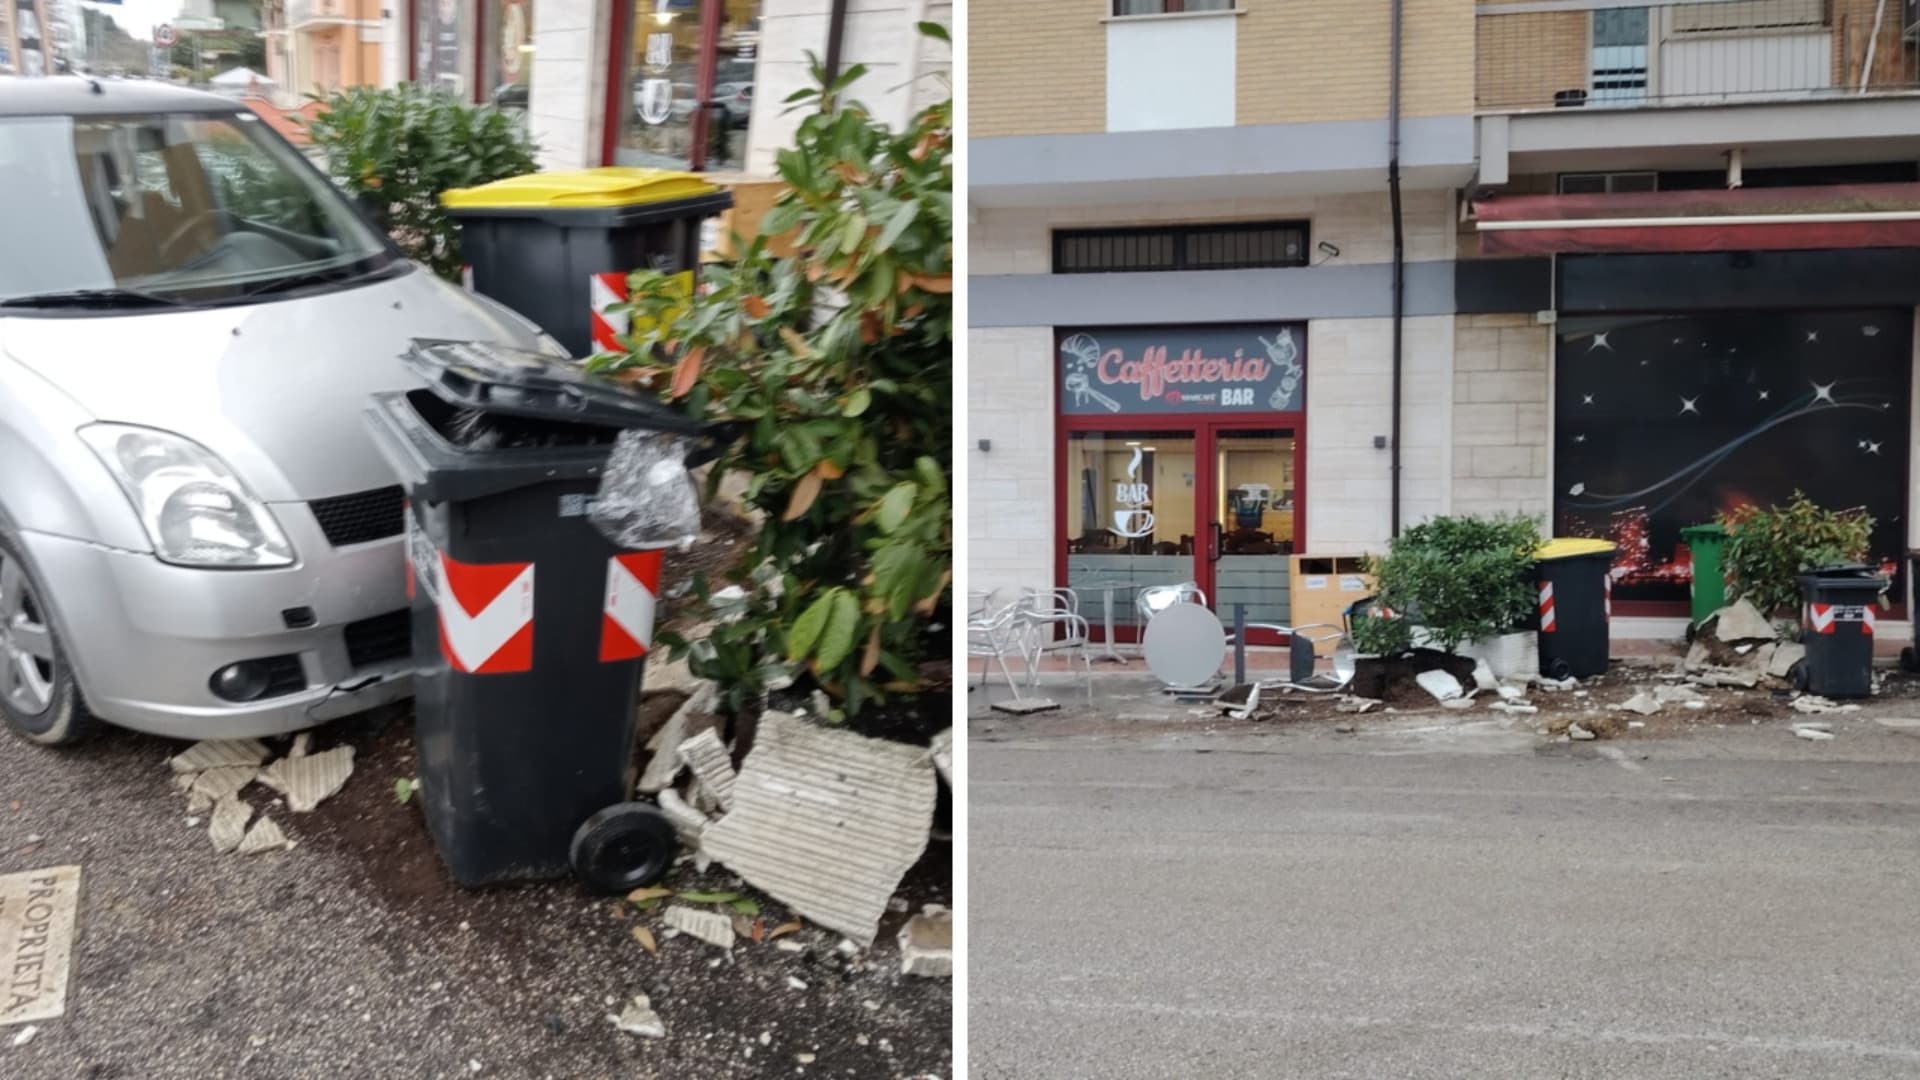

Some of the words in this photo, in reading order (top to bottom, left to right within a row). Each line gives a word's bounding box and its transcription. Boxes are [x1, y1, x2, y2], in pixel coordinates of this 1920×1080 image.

[1097, 345, 1271, 401] Caffetteria
[1221, 388, 1254, 406] BAR
[1115, 483, 1149, 503] BAR
